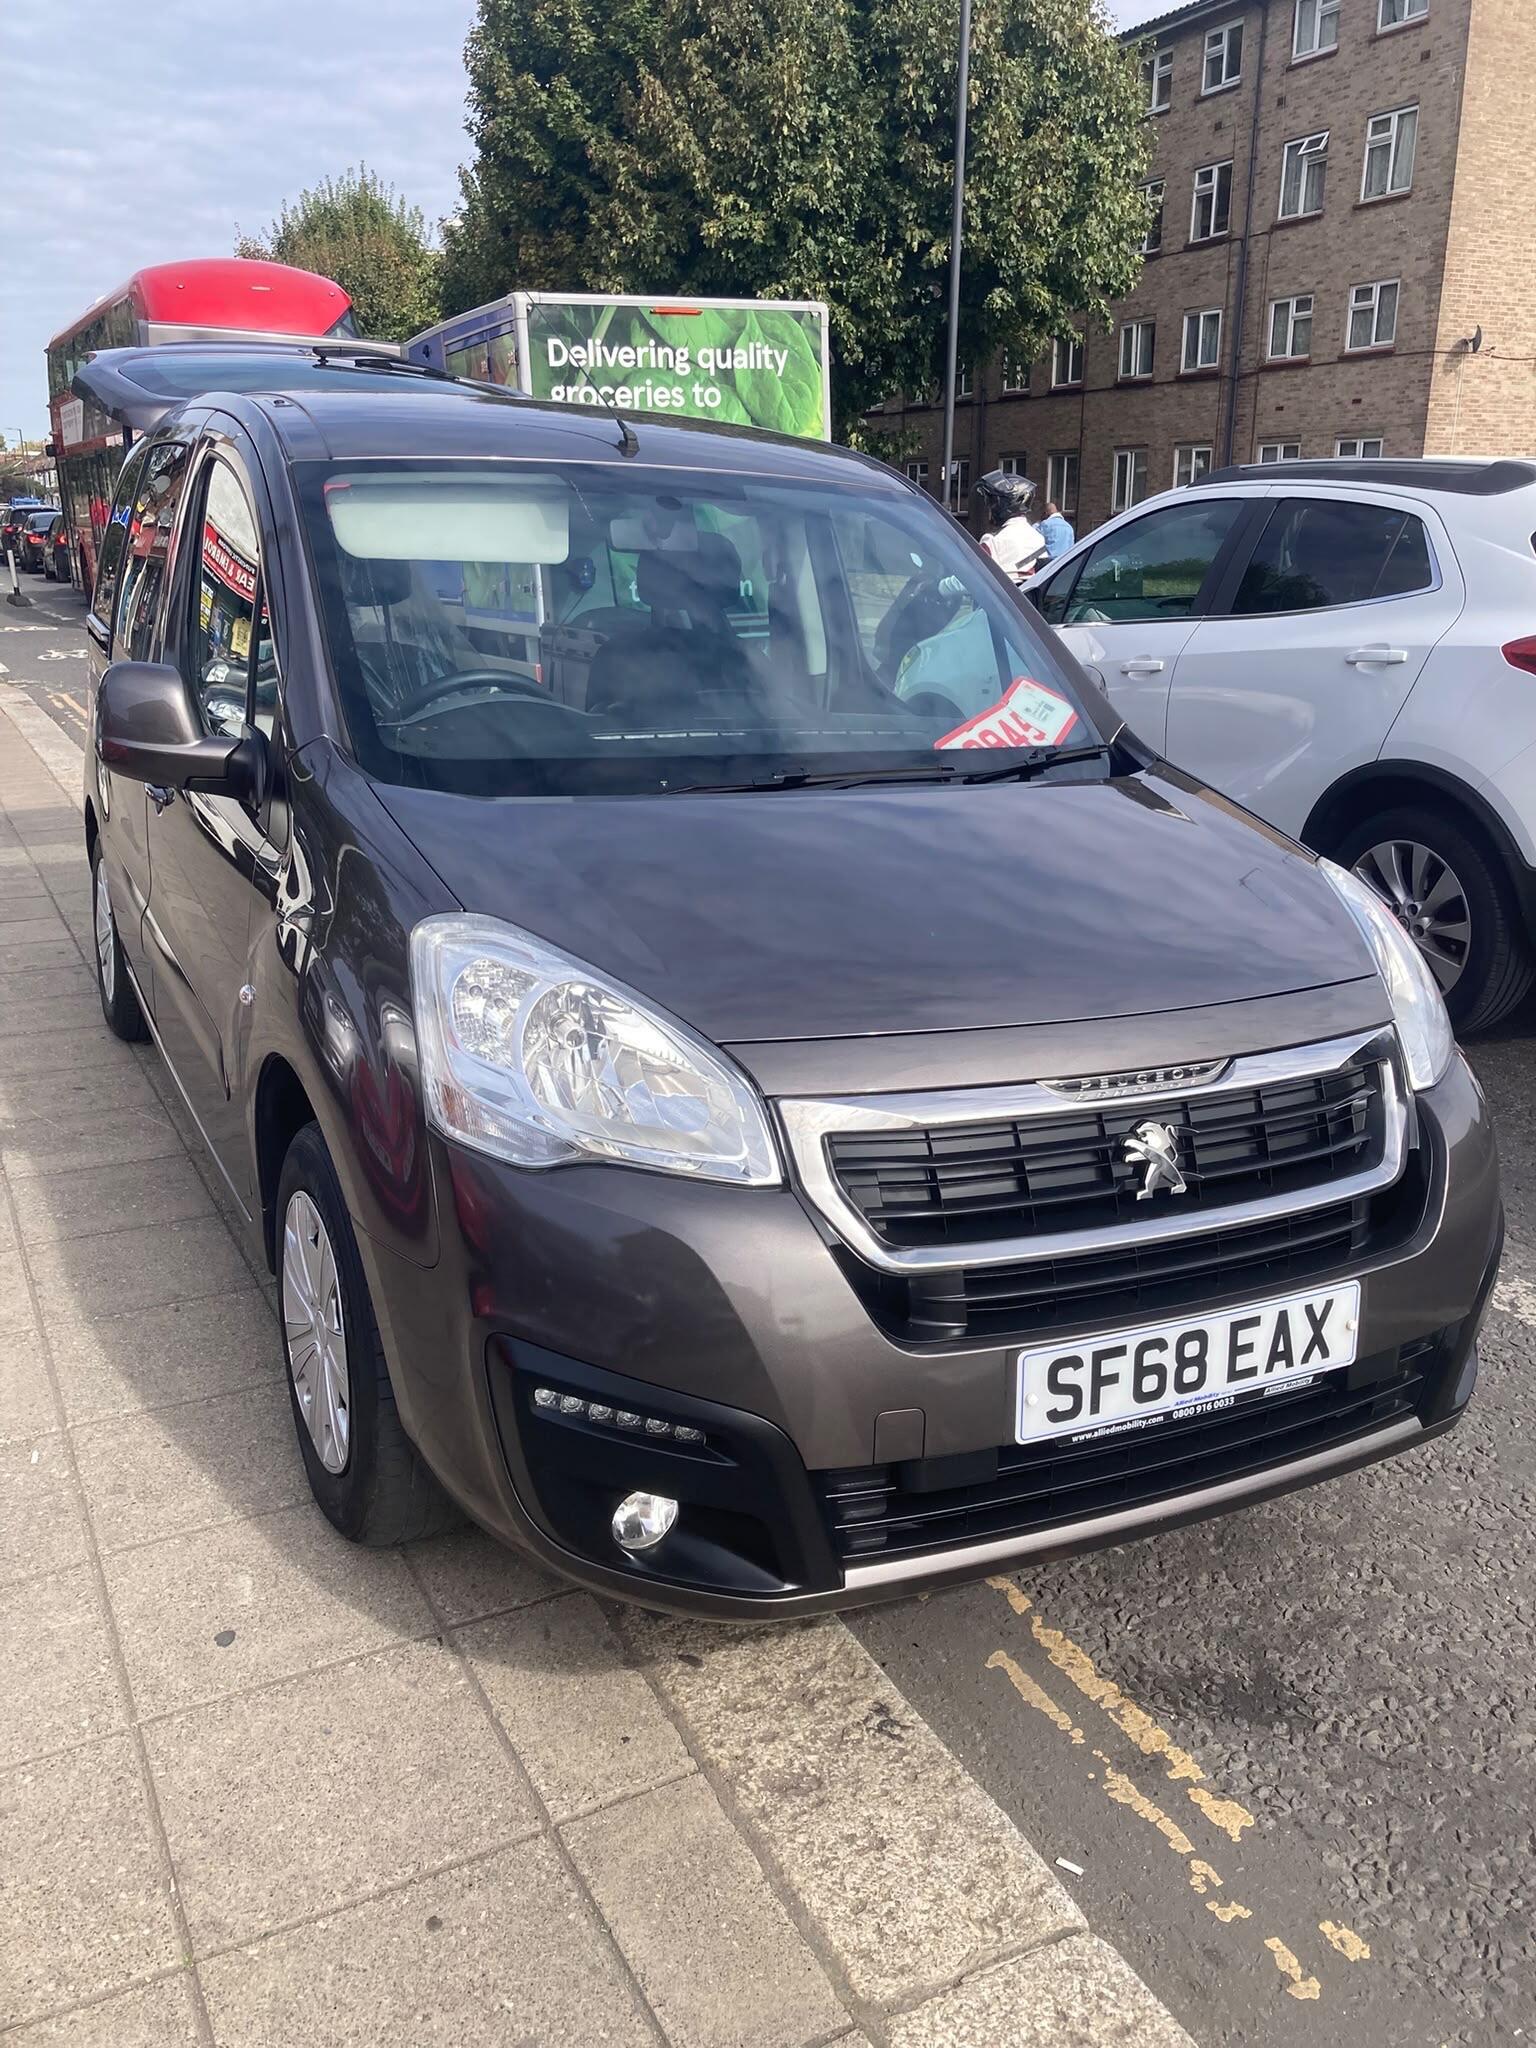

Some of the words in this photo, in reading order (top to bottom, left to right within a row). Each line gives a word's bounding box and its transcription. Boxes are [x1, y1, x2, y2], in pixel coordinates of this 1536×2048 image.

[547, 338, 692, 376] Delivering
[697, 342, 789, 377] quality
[551, 379, 686, 410] groceries
[692, 381, 722, 408] to
[962, 710, 1047, 750] 945
[1080, 1066, 1201, 1091] PEUGEOT
[1046, 1328, 1209, 1424] SF68
[1226, 1298, 1335, 1384] EAX
[1265, 1383, 1285, 1394] Allied
[1284, 1377, 1311, 1389] Mobility
[1071, 1415, 1165, 1443] www.alliedmobility.com
[1172, 1406, 1195, 1420] 0800
[1195, 1402, 1213, 1414] 916
[1213, 1396, 1235, 1409] 0033
